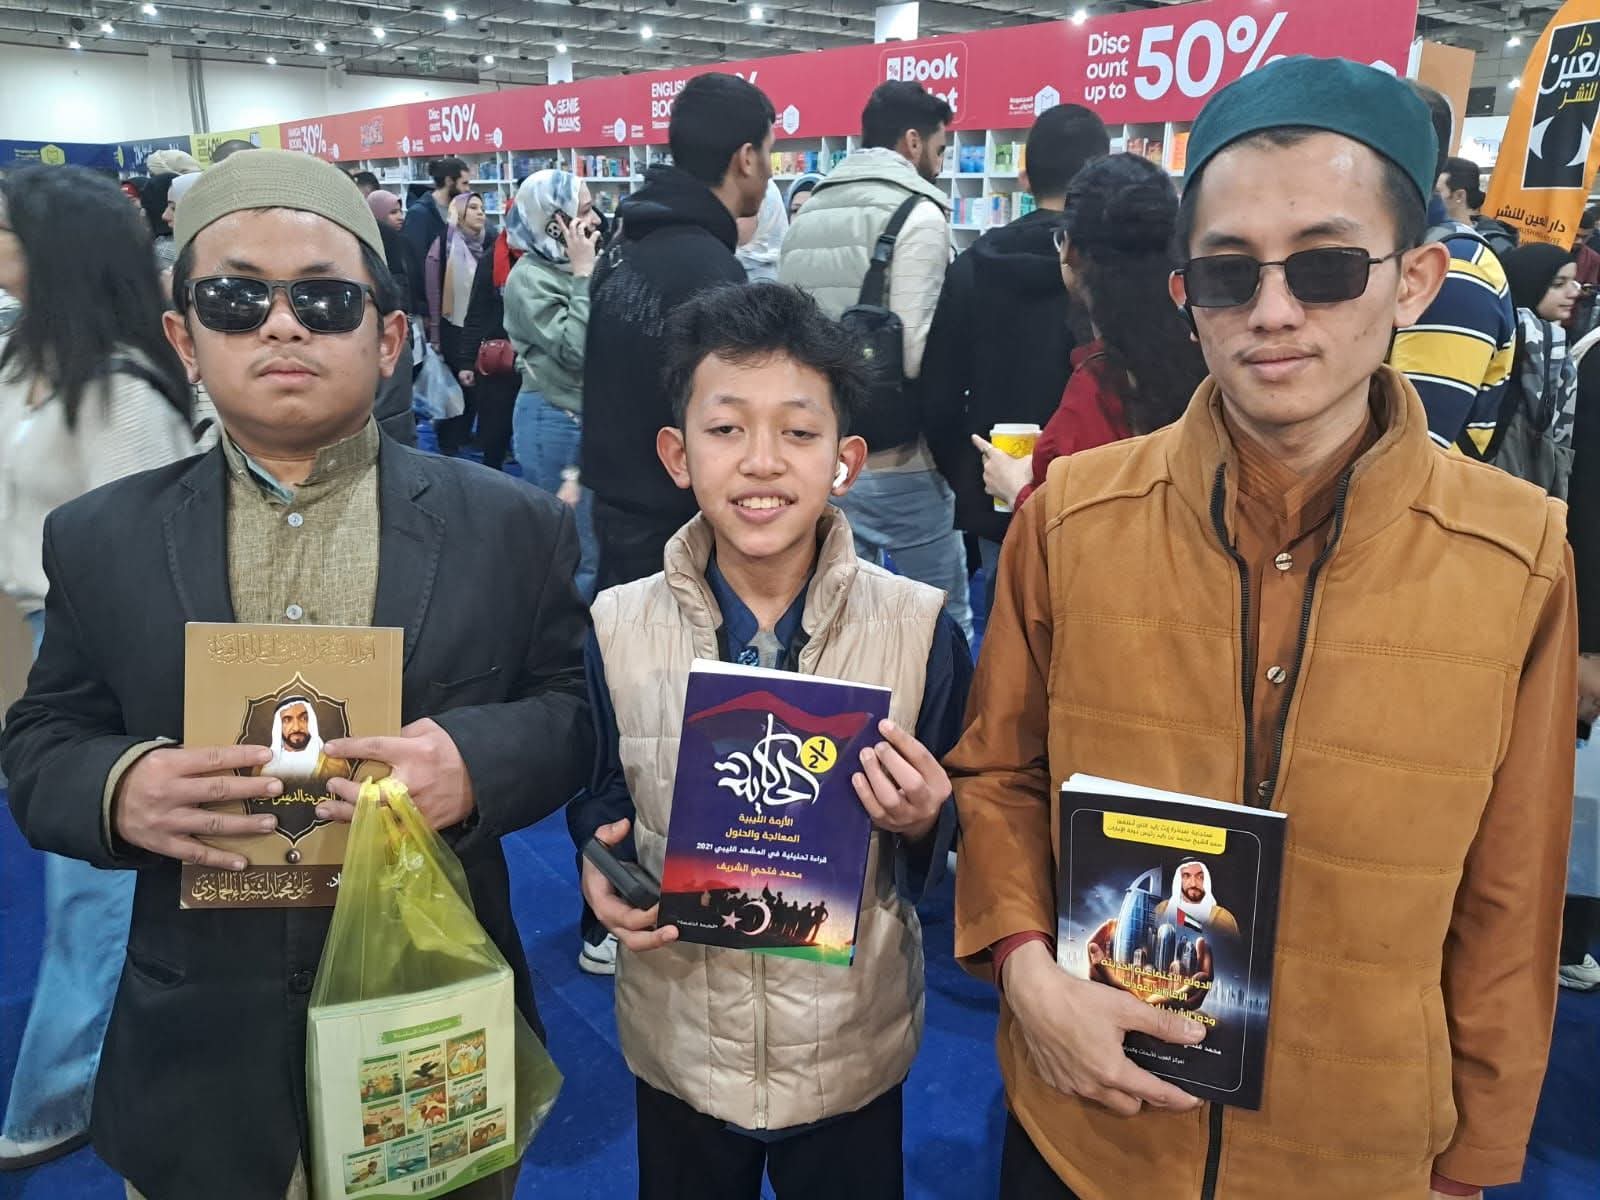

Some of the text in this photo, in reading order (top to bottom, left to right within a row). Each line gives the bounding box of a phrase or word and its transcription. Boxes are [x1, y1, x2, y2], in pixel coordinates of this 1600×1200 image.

[1088, 32, 1130, 57] Disc
[1568, 26, 1593, 54] دار
[903, 52, 959, 82] Book
[1134, 11, 1288, 100] 50%
[1086, 57, 1129, 80] ount
[1540, 51, 1600, 95] لعين
[651, 80, 686, 98] ENGLIS
[1084, 81, 1127, 104] up to
[1558, 82, 1599, 110] للنشر
[441, 103, 480, 143] 50%
[300, 123, 327, 154] 30%
[1525, 213, 1549, 227] العين
[1547, 219, 1566, 233] دار
[738, 813, 794, 828] الأزمة الليبية
[725, 827, 800, 843] المعالجة والحلول
[696, 842, 828, 864] قراءة تحليلية في المشهد الليبي 2021
[716, 861, 803, 879] محمد فتحي الشريف
[1203, 1045, 1222, 1055] محمد
